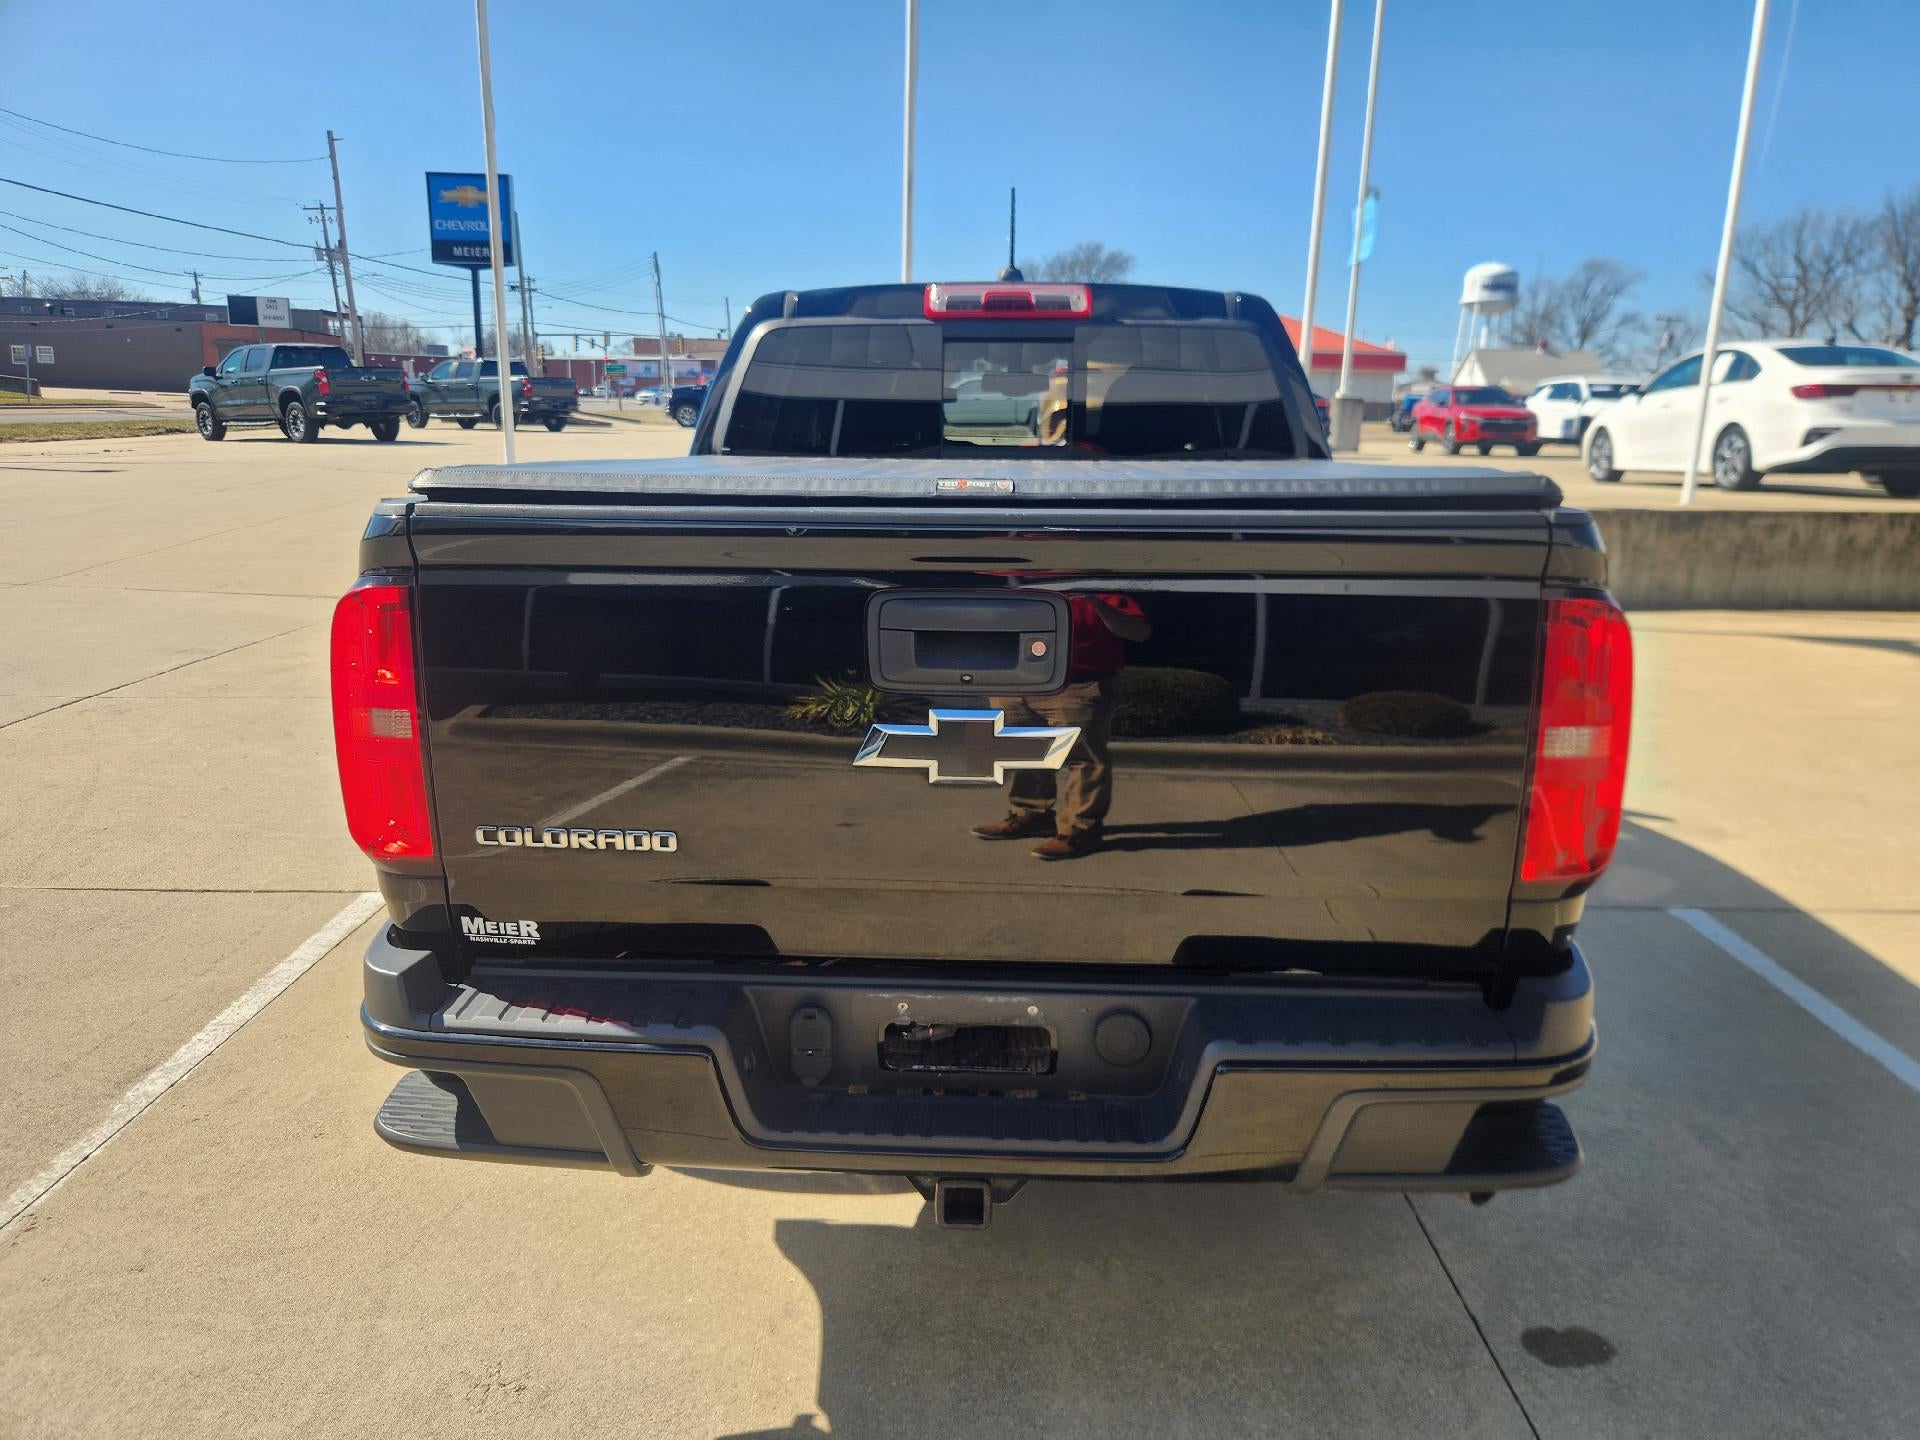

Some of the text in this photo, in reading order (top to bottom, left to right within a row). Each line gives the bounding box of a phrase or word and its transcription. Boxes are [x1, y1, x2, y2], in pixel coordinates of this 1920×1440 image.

[434, 219, 504, 231] CHEVROL
[452, 246, 490, 257] MEIER
[475, 824, 678, 852] COLORADO
[460, 915, 541, 938] MEIER
[469, 935, 537, 946] NASHVILLE-SPARTA
